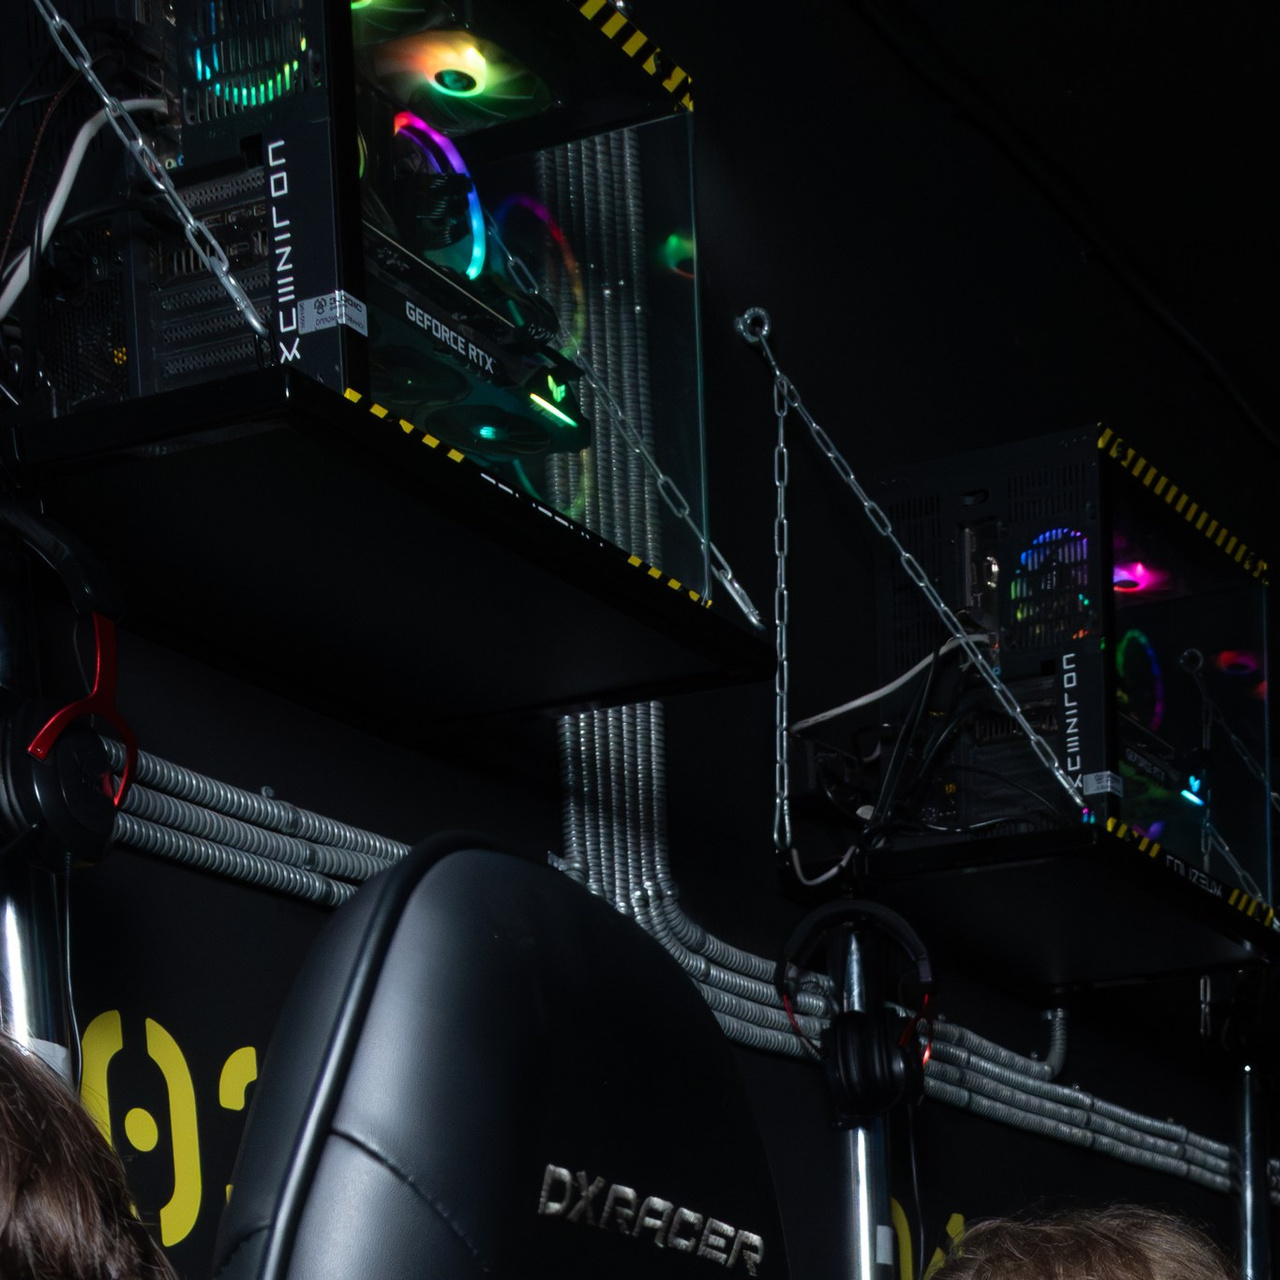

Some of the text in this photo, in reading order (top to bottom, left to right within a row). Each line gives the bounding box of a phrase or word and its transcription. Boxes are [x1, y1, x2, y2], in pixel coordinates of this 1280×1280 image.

[404, 300, 496, 375] GEFORCE RTX
[537, 1162, 766, 1278] DXRACER
